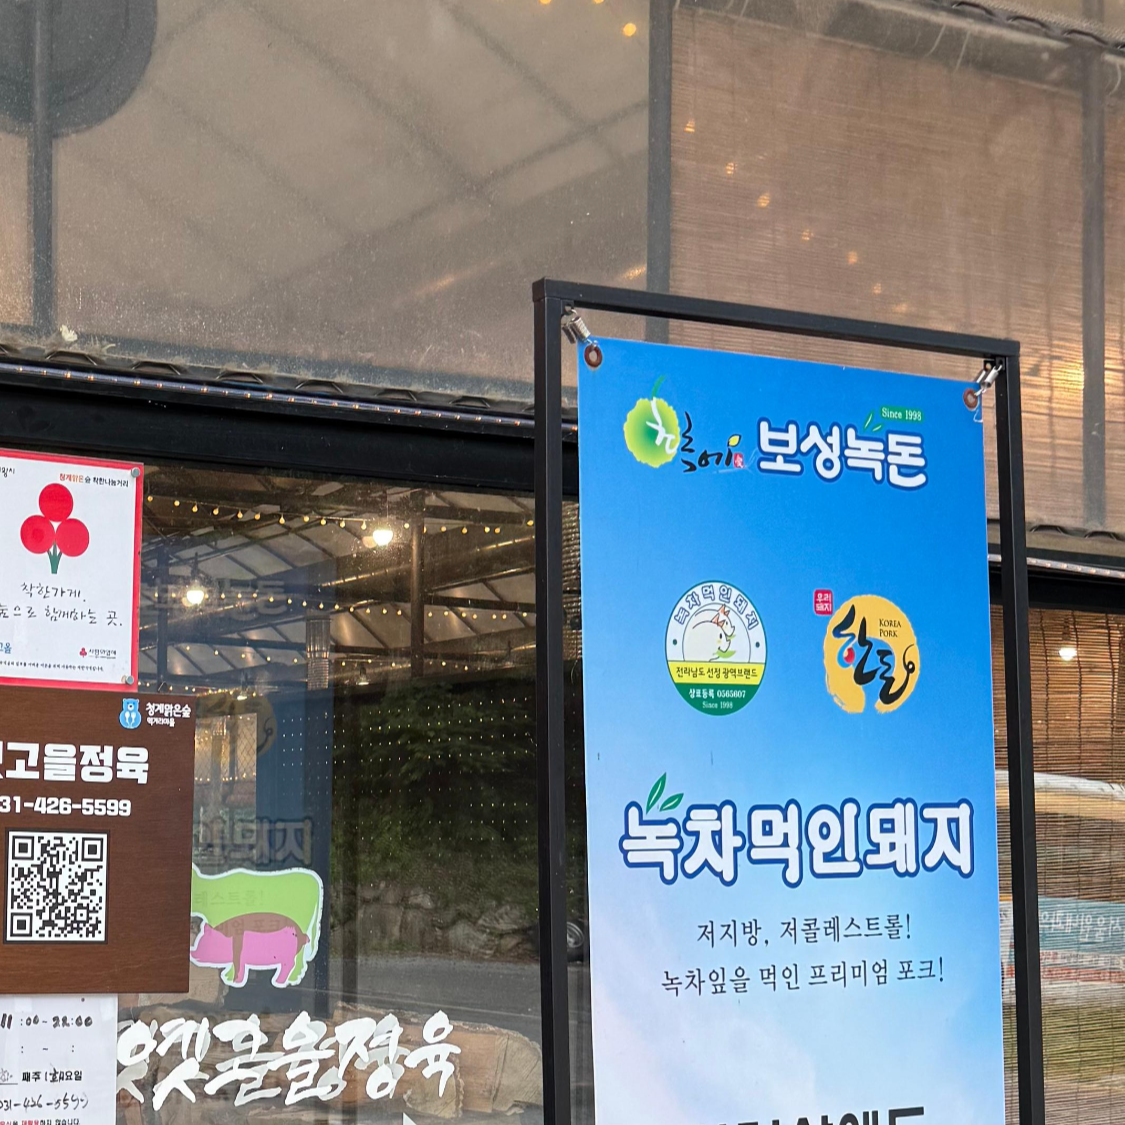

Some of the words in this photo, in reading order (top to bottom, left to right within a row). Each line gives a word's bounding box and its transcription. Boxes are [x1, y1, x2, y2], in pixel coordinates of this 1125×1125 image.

[882, 407, 902, 420] Since
[905, 410, 922, 421] 1998
[758, 418, 927, 489] 보성녹돈
[879, 618, 902, 628] KOREA
[879, 629, 898, 638] PORK
[702, 700, 718, 709] Since
[719, 701, 733, 709] 1998
[618, 797, 975, 889] 녹차먹인돼지
[696, 918, 770, 949] 저지방,
[779, 913, 912, 945] 저콜레스트롤!
[661, 966, 751, 997] 녹차잎을
[758, 964, 801, 993] 먹인
[807, 958, 889, 989] 프리미엄
[896, 955, 945, 983] 포크!
